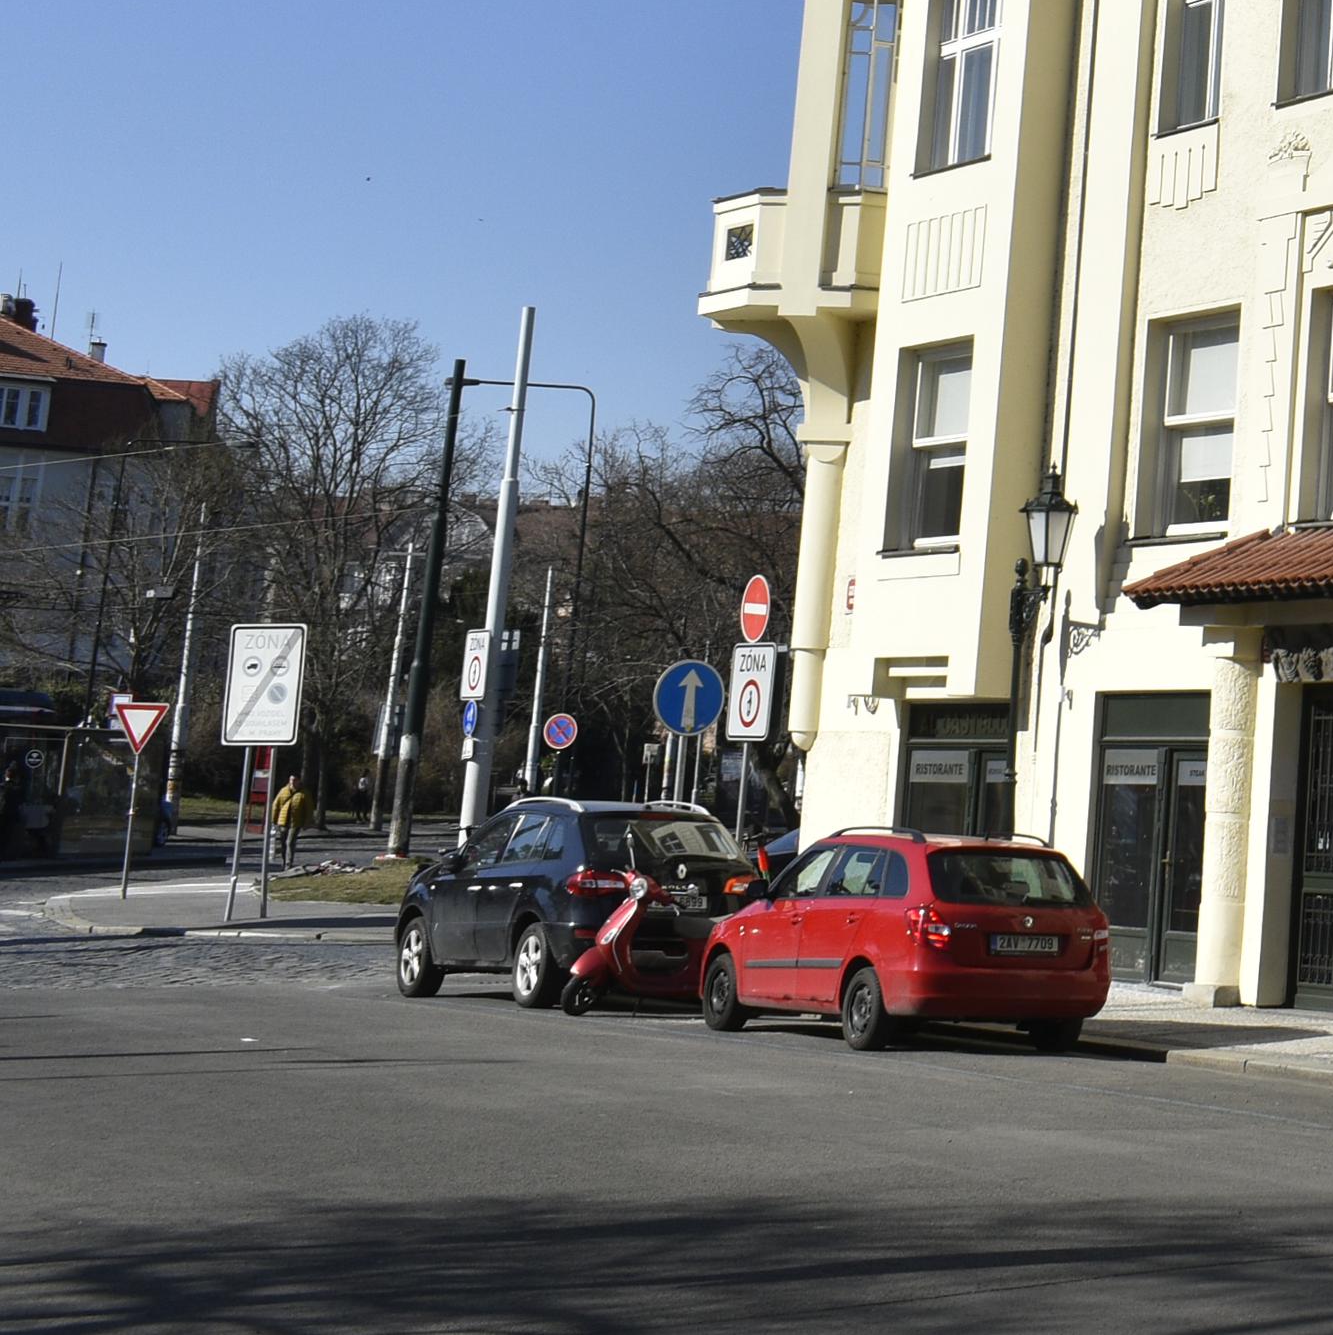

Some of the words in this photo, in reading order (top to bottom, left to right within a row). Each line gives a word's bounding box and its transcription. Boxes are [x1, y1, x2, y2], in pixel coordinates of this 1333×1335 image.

[739, 649, 767, 672] ZÓNA
[915, 763, 964, 775] RISTORANTE
[1106, 764, 1157, 776] RISTORANTE
[999, 936, 1019, 950] 2AV
[1027, 936, 1054, 950] 7709
